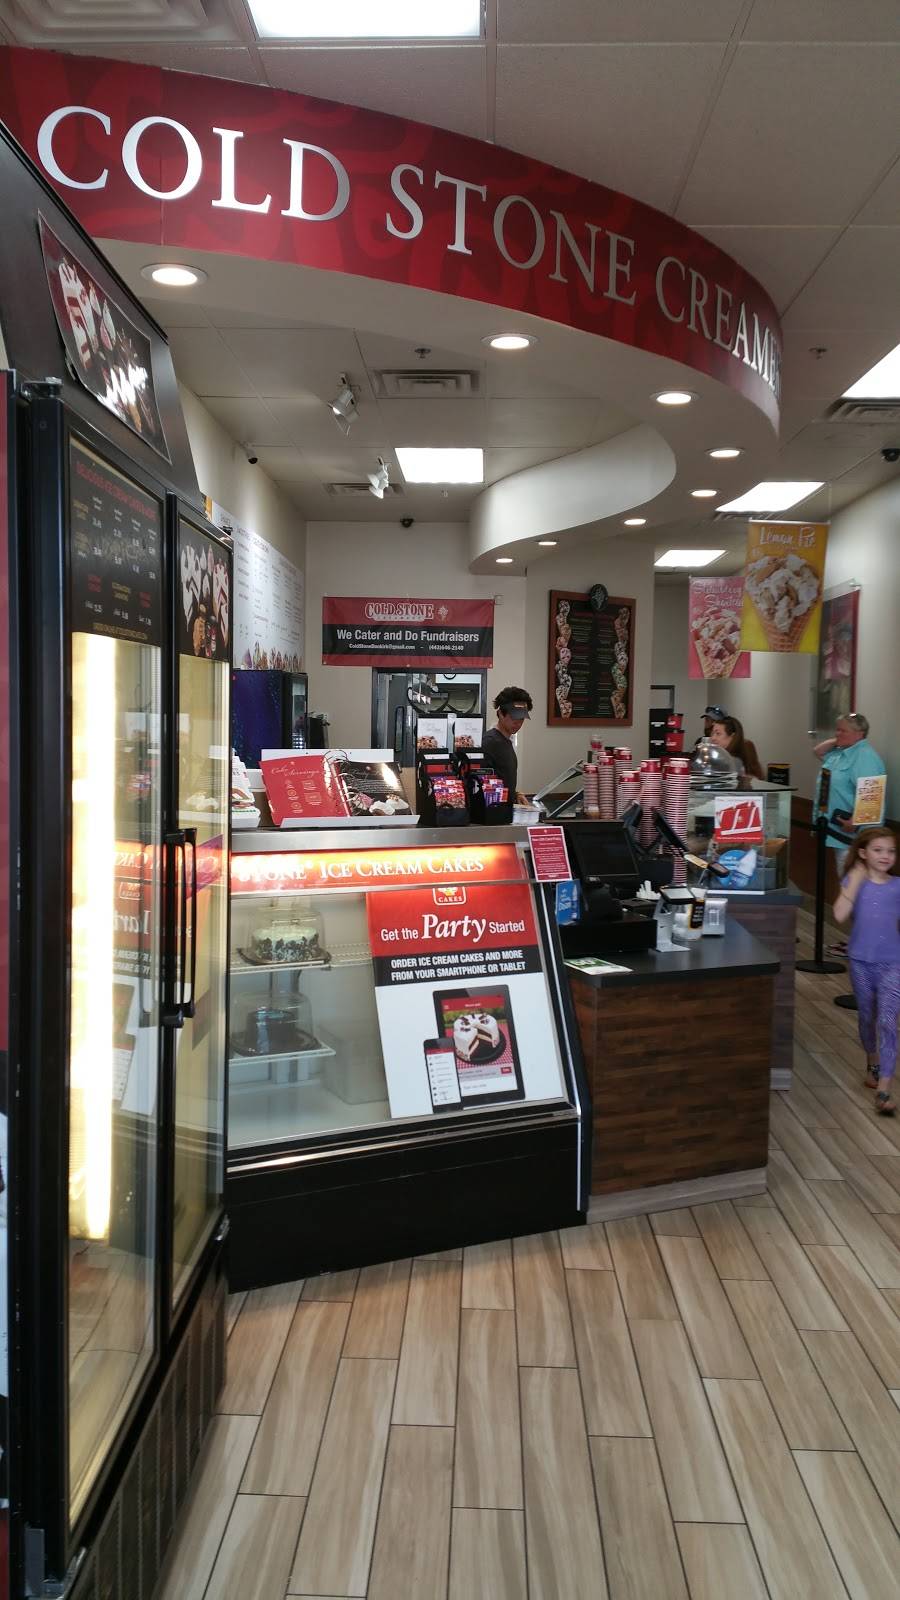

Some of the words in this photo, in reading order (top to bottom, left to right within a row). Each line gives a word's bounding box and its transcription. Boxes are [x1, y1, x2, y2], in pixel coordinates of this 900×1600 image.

[37, 105, 350, 221] COLD
[385, 163, 637, 305] STONE
[365, 602, 396, 619] COLD
[396, 602, 434, 619] STONE
[337, 629, 353, 640] We
[354, 629, 382, 641] Cater
[383, 630, 402, 641] and
[404, 630, 418, 641] Do
[420, 630, 480, 643] Fundraisers
[319, 861, 353, 879] ICE
[356, 859, 424, 877] CREAM
[427, 855, 485, 874] CAKES
[437, 895, 463, 903] CAKES
[380, 928, 400, 941] Get
[401, 927, 419, 940] the
[421, 913, 487, 943] Party
[488, 919, 526, 934] Started
[391, 957, 417, 969] ORDER
[418, 956, 432, 967] ICE
[432, 953, 459, 966] CREAM
[459, 951, 484, 963] CAKES
[485, 950, 501, 961] AND
[501, 949, 524, 960] MORE
[391, 970, 414, 981] FROM
[414, 968, 436, 980] YOUR
[436, 964, 488, 977] SMARTPHONE
[487, 963, 499, 973] OR
[499, 961, 526, 972] TABLET
